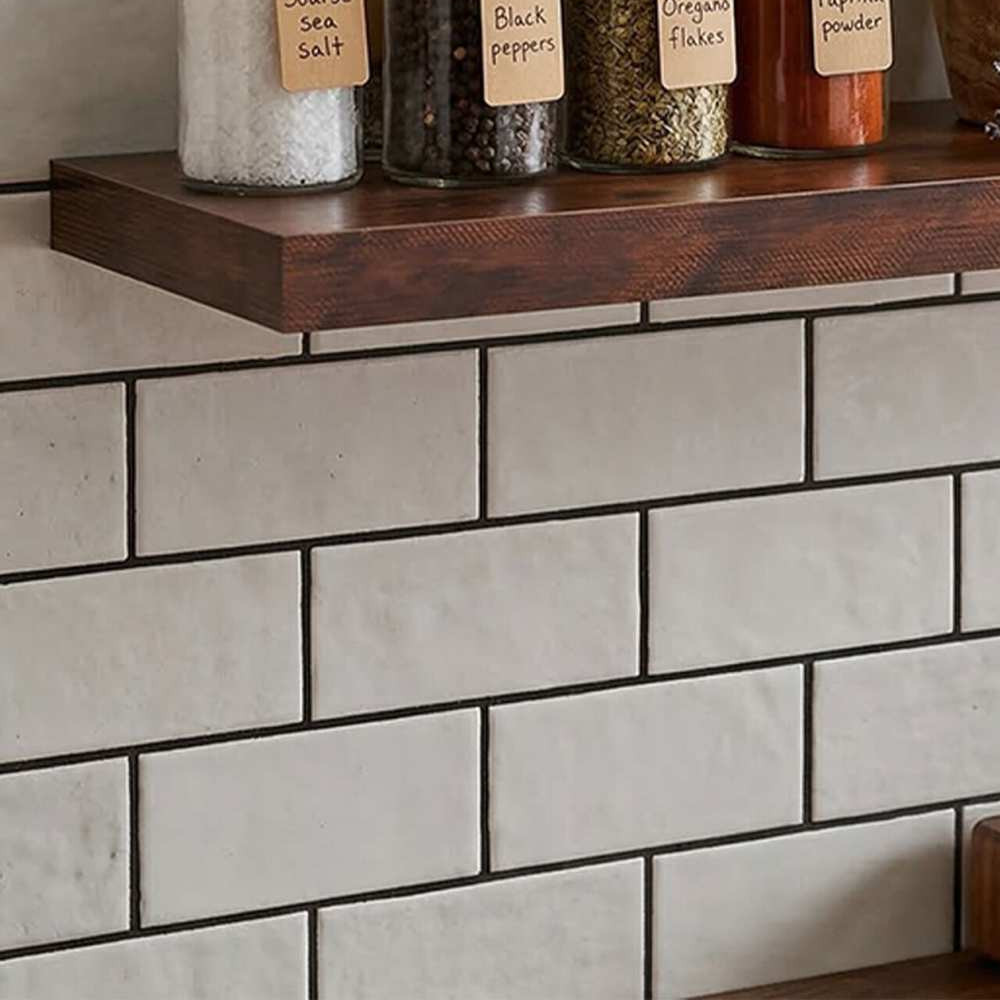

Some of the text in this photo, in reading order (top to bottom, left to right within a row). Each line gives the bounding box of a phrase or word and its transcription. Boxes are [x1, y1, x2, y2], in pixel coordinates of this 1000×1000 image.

[299, 15, 338, 32] sea
[494, 5, 547, 30] Black
[822, 12, 882, 42] powder
[298, 35, 345, 59] salt
[667, 25, 725, 50] flakes
[491, 36, 556, 66] peppers
